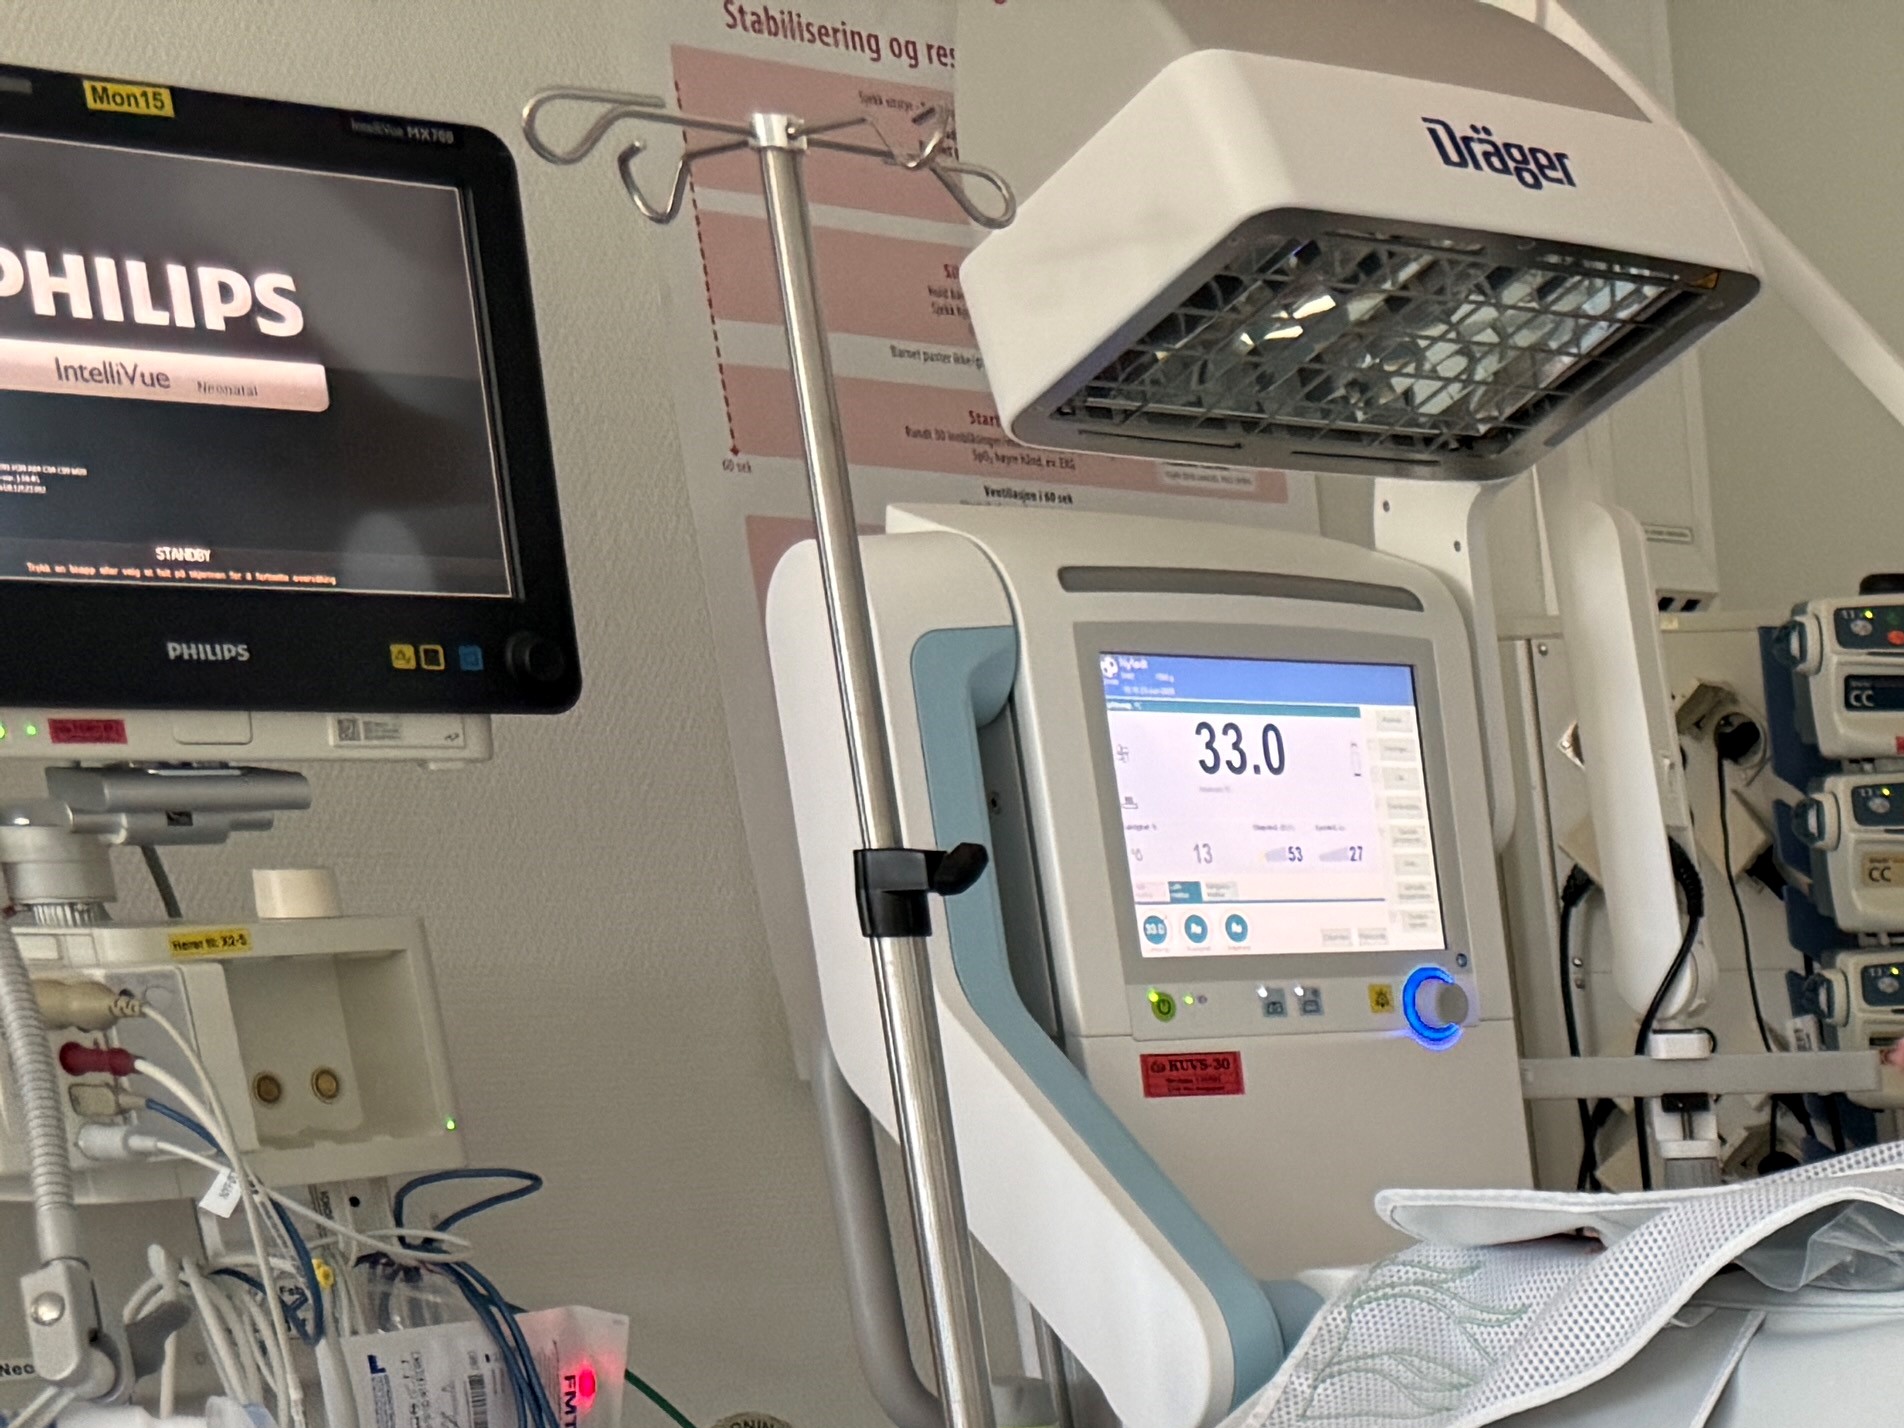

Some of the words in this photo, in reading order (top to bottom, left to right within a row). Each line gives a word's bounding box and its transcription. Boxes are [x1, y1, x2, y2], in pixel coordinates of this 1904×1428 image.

[724, 0, 881, 62] Stabilisering
[889, 36, 919, 68] og
[91, 85, 166, 111] Mon15
[1421, 116, 1577, 190] Dräger
[54, 357, 170, 390] IntelliVue
[155, 547, 211, 562] STANDBY
[167, 642, 249, 661] PHILIPS
[1195, 721, 1285, 775] 33.0
[1288, 846, 1303, 862] 53
[1350, 845, 1363, 862] 27
